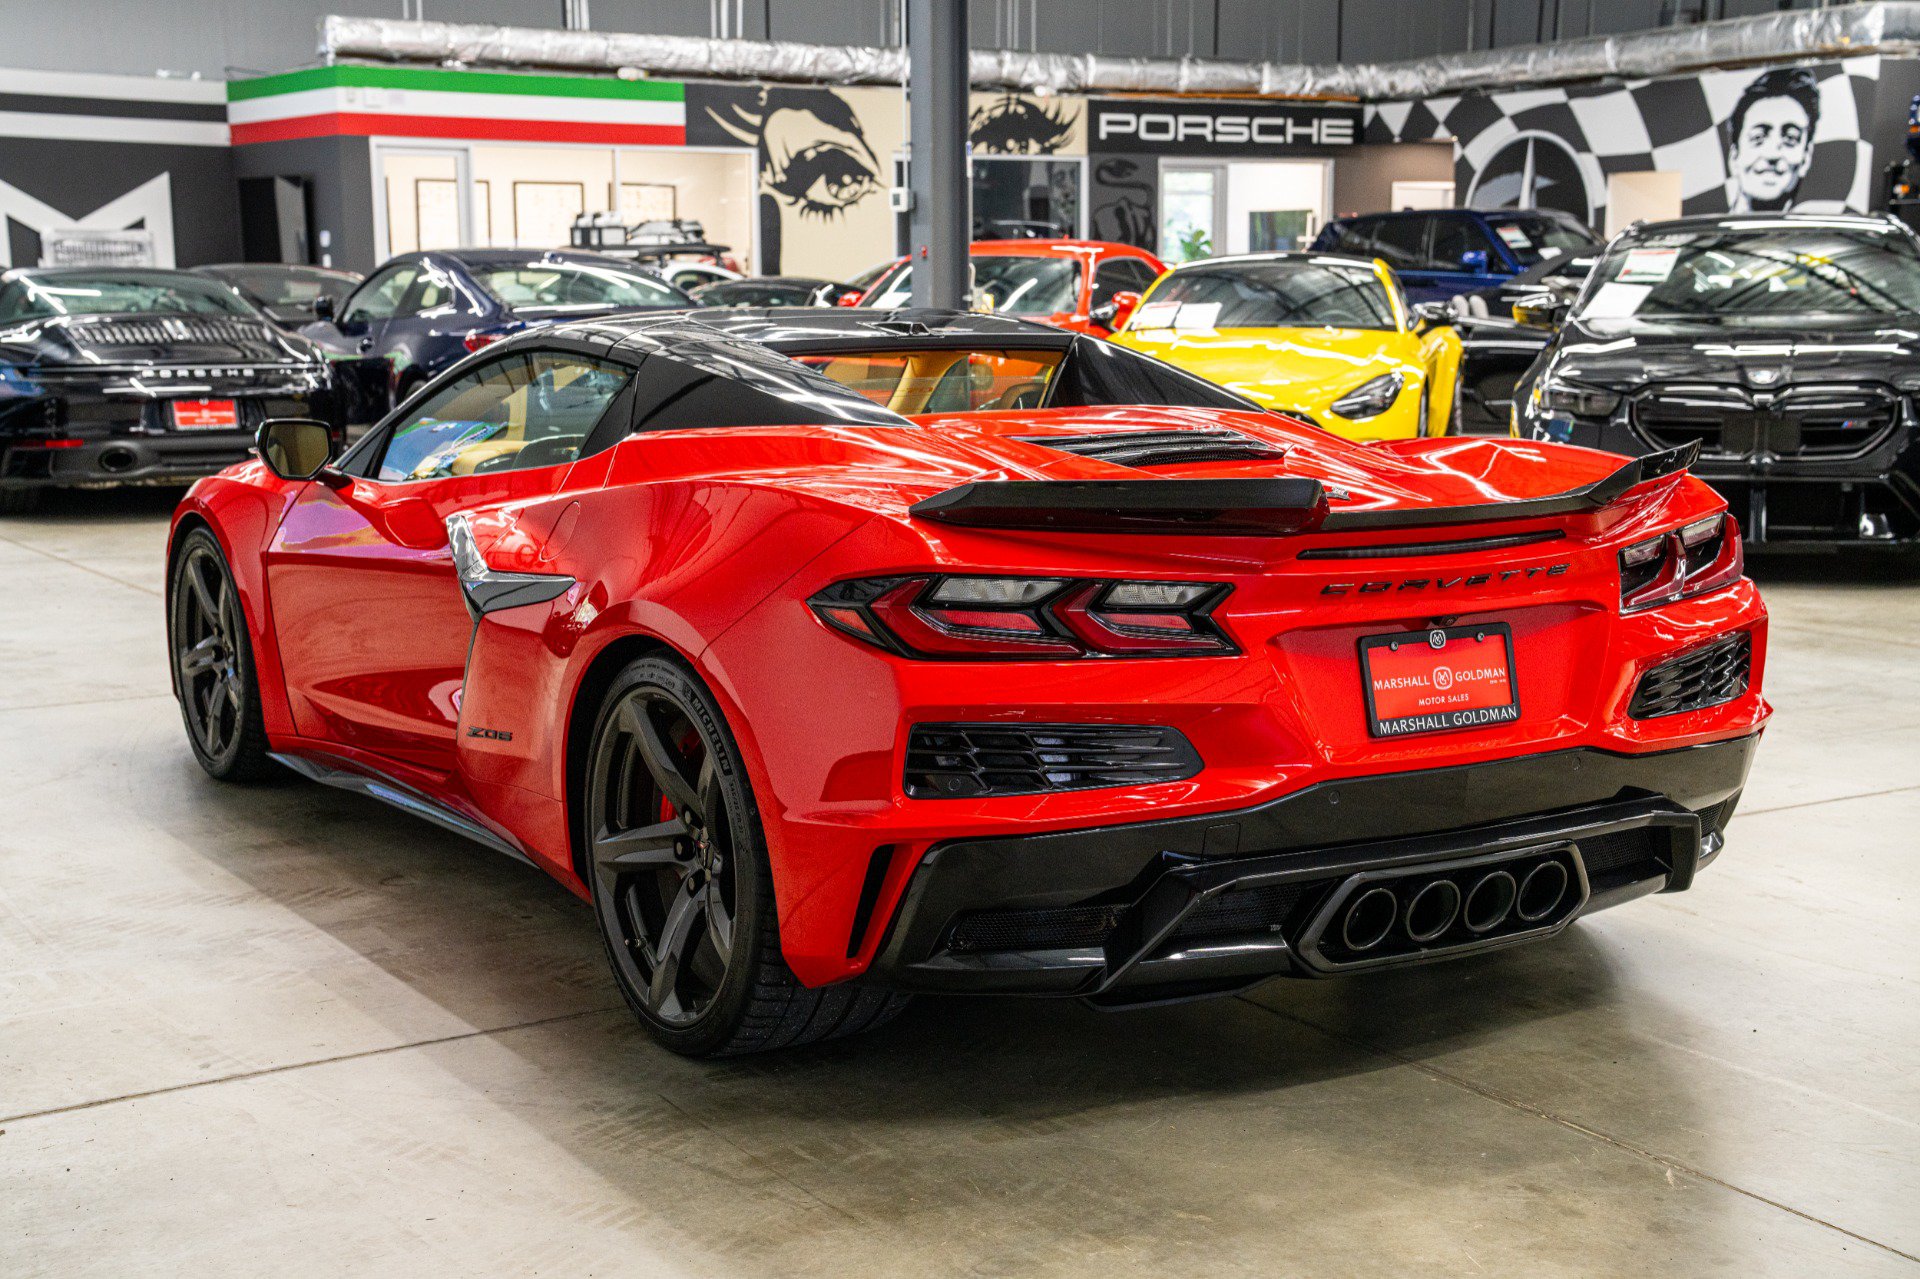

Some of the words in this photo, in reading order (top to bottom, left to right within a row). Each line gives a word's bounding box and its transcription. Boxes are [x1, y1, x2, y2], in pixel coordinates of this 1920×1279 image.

[1098, 112, 1354, 144] PORSCHE
[1319, 563, 1572, 595] CORVETTE
[1373, 675, 1430, 691] MARSHALL
[1455, 667, 1506, 682] GOLDMAN
[1418, 695, 1445, 706] MOTOR
[1447, 693, 1469, 703] SALES
[692, 697, 731, 773] MICHELIN
[1379, 714, 1450, 735] MARSHALL
[1453, 706, 1518, 726] GOLDMAN
